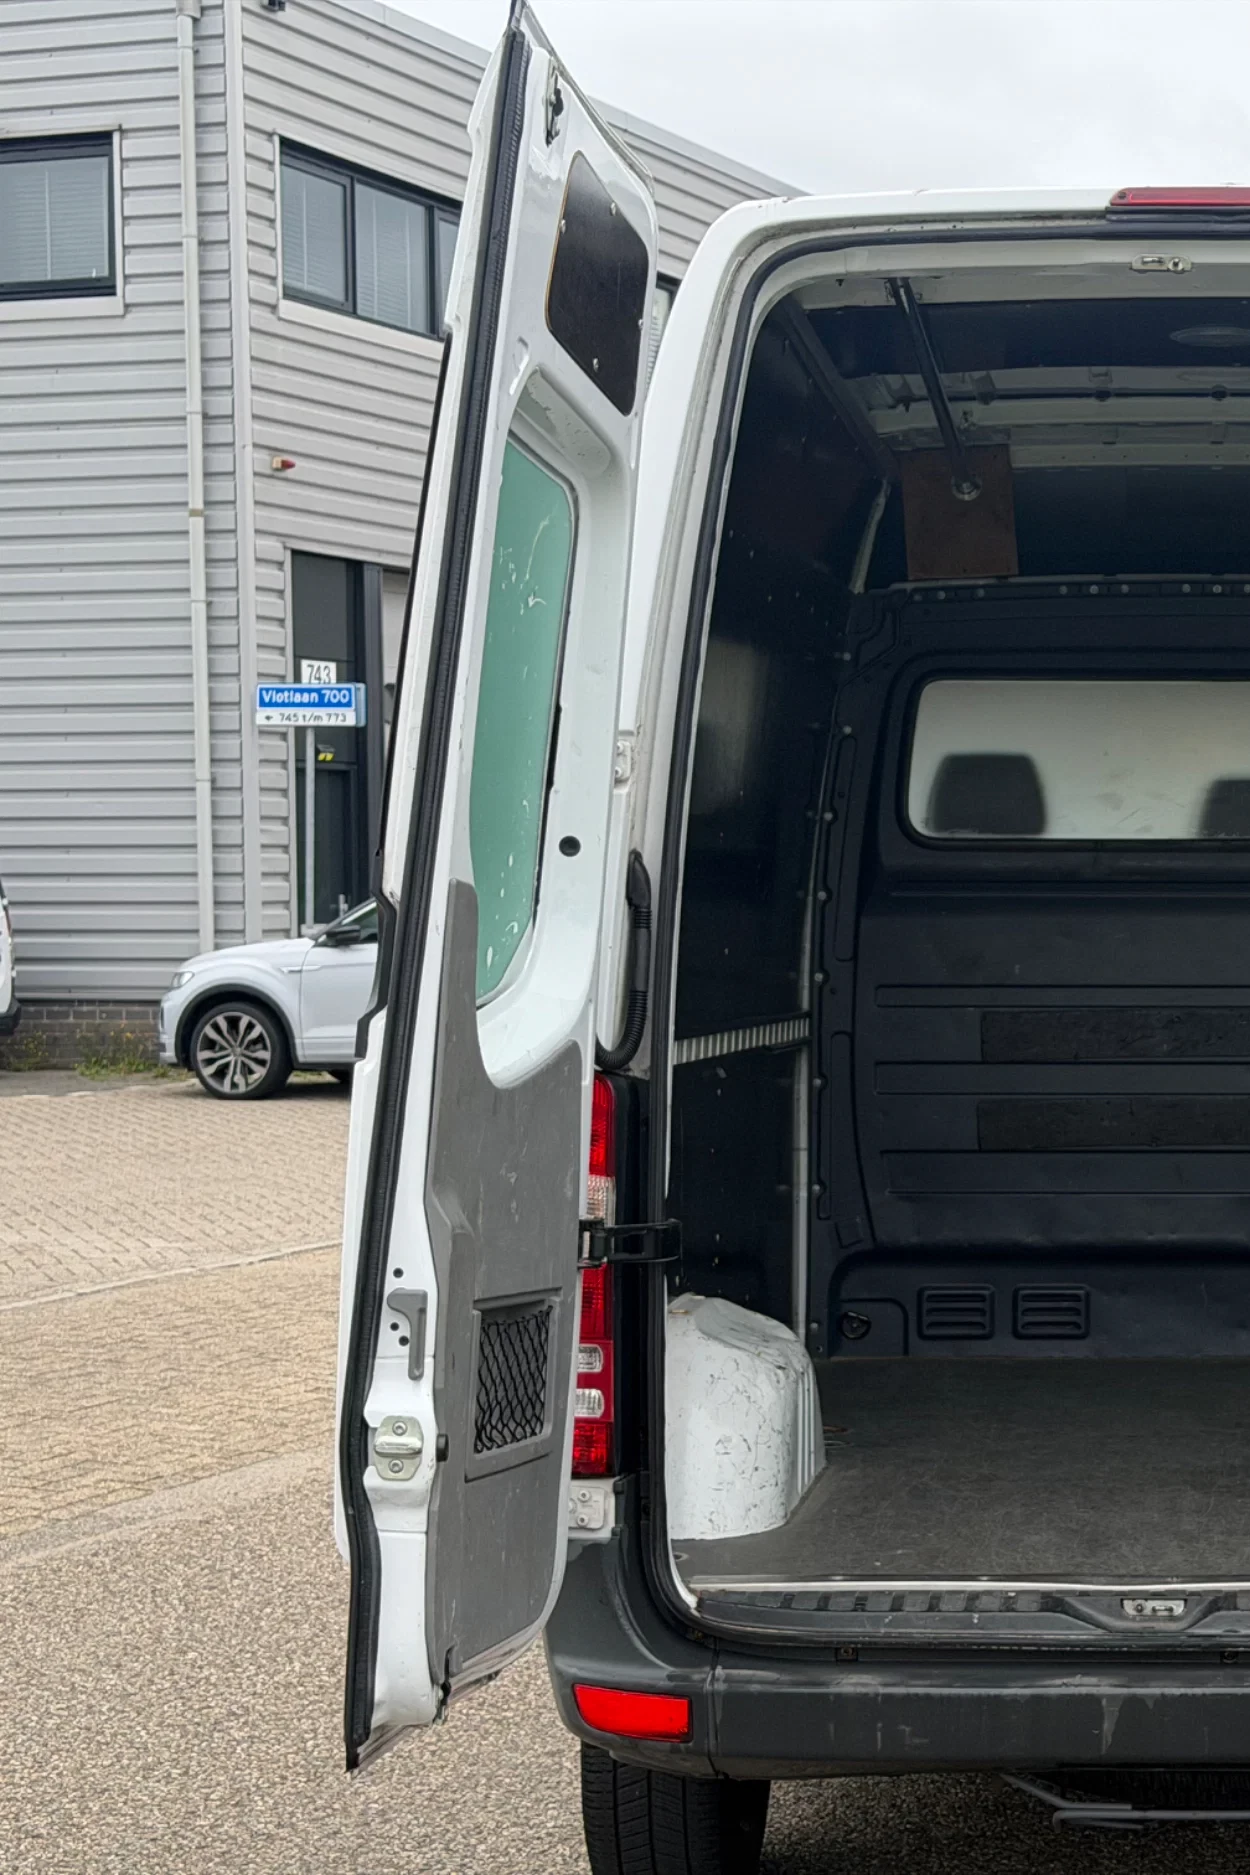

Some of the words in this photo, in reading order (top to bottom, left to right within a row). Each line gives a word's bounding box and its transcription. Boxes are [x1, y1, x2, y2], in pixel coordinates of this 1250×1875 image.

[307, 664, 331, 683] 743
[261, 689, 319, 704] Vlotlaan
[321, 689, 350, 704] 700
[279, 712, 299, 723] 745
[302, 712, 323, 723] t/m
[325, 712, 347, 723] 773
